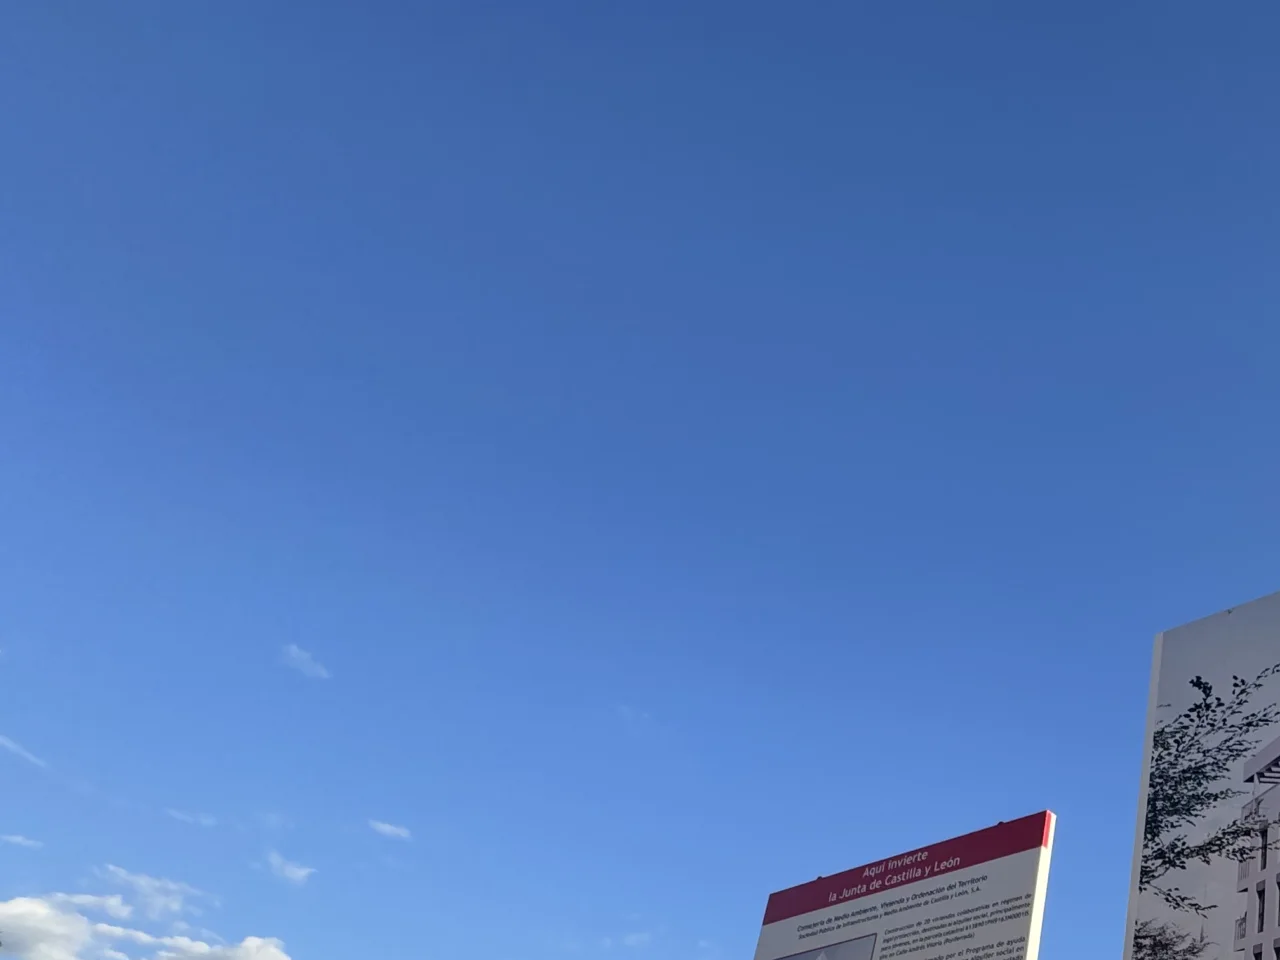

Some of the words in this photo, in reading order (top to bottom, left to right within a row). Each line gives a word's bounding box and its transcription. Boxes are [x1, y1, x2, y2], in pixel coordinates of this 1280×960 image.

[828, 892, 836, 902] la
[839, 884, 866, 898] Junta
[869, 879, 882, 890] de
[885, 867, 921, 885] Castilla
[924, 866, 931, 876] y
[934, 857, 960, 871] León
[862, 862, 885, 877] Aquí
[888, 851, 928, 868] invierte
